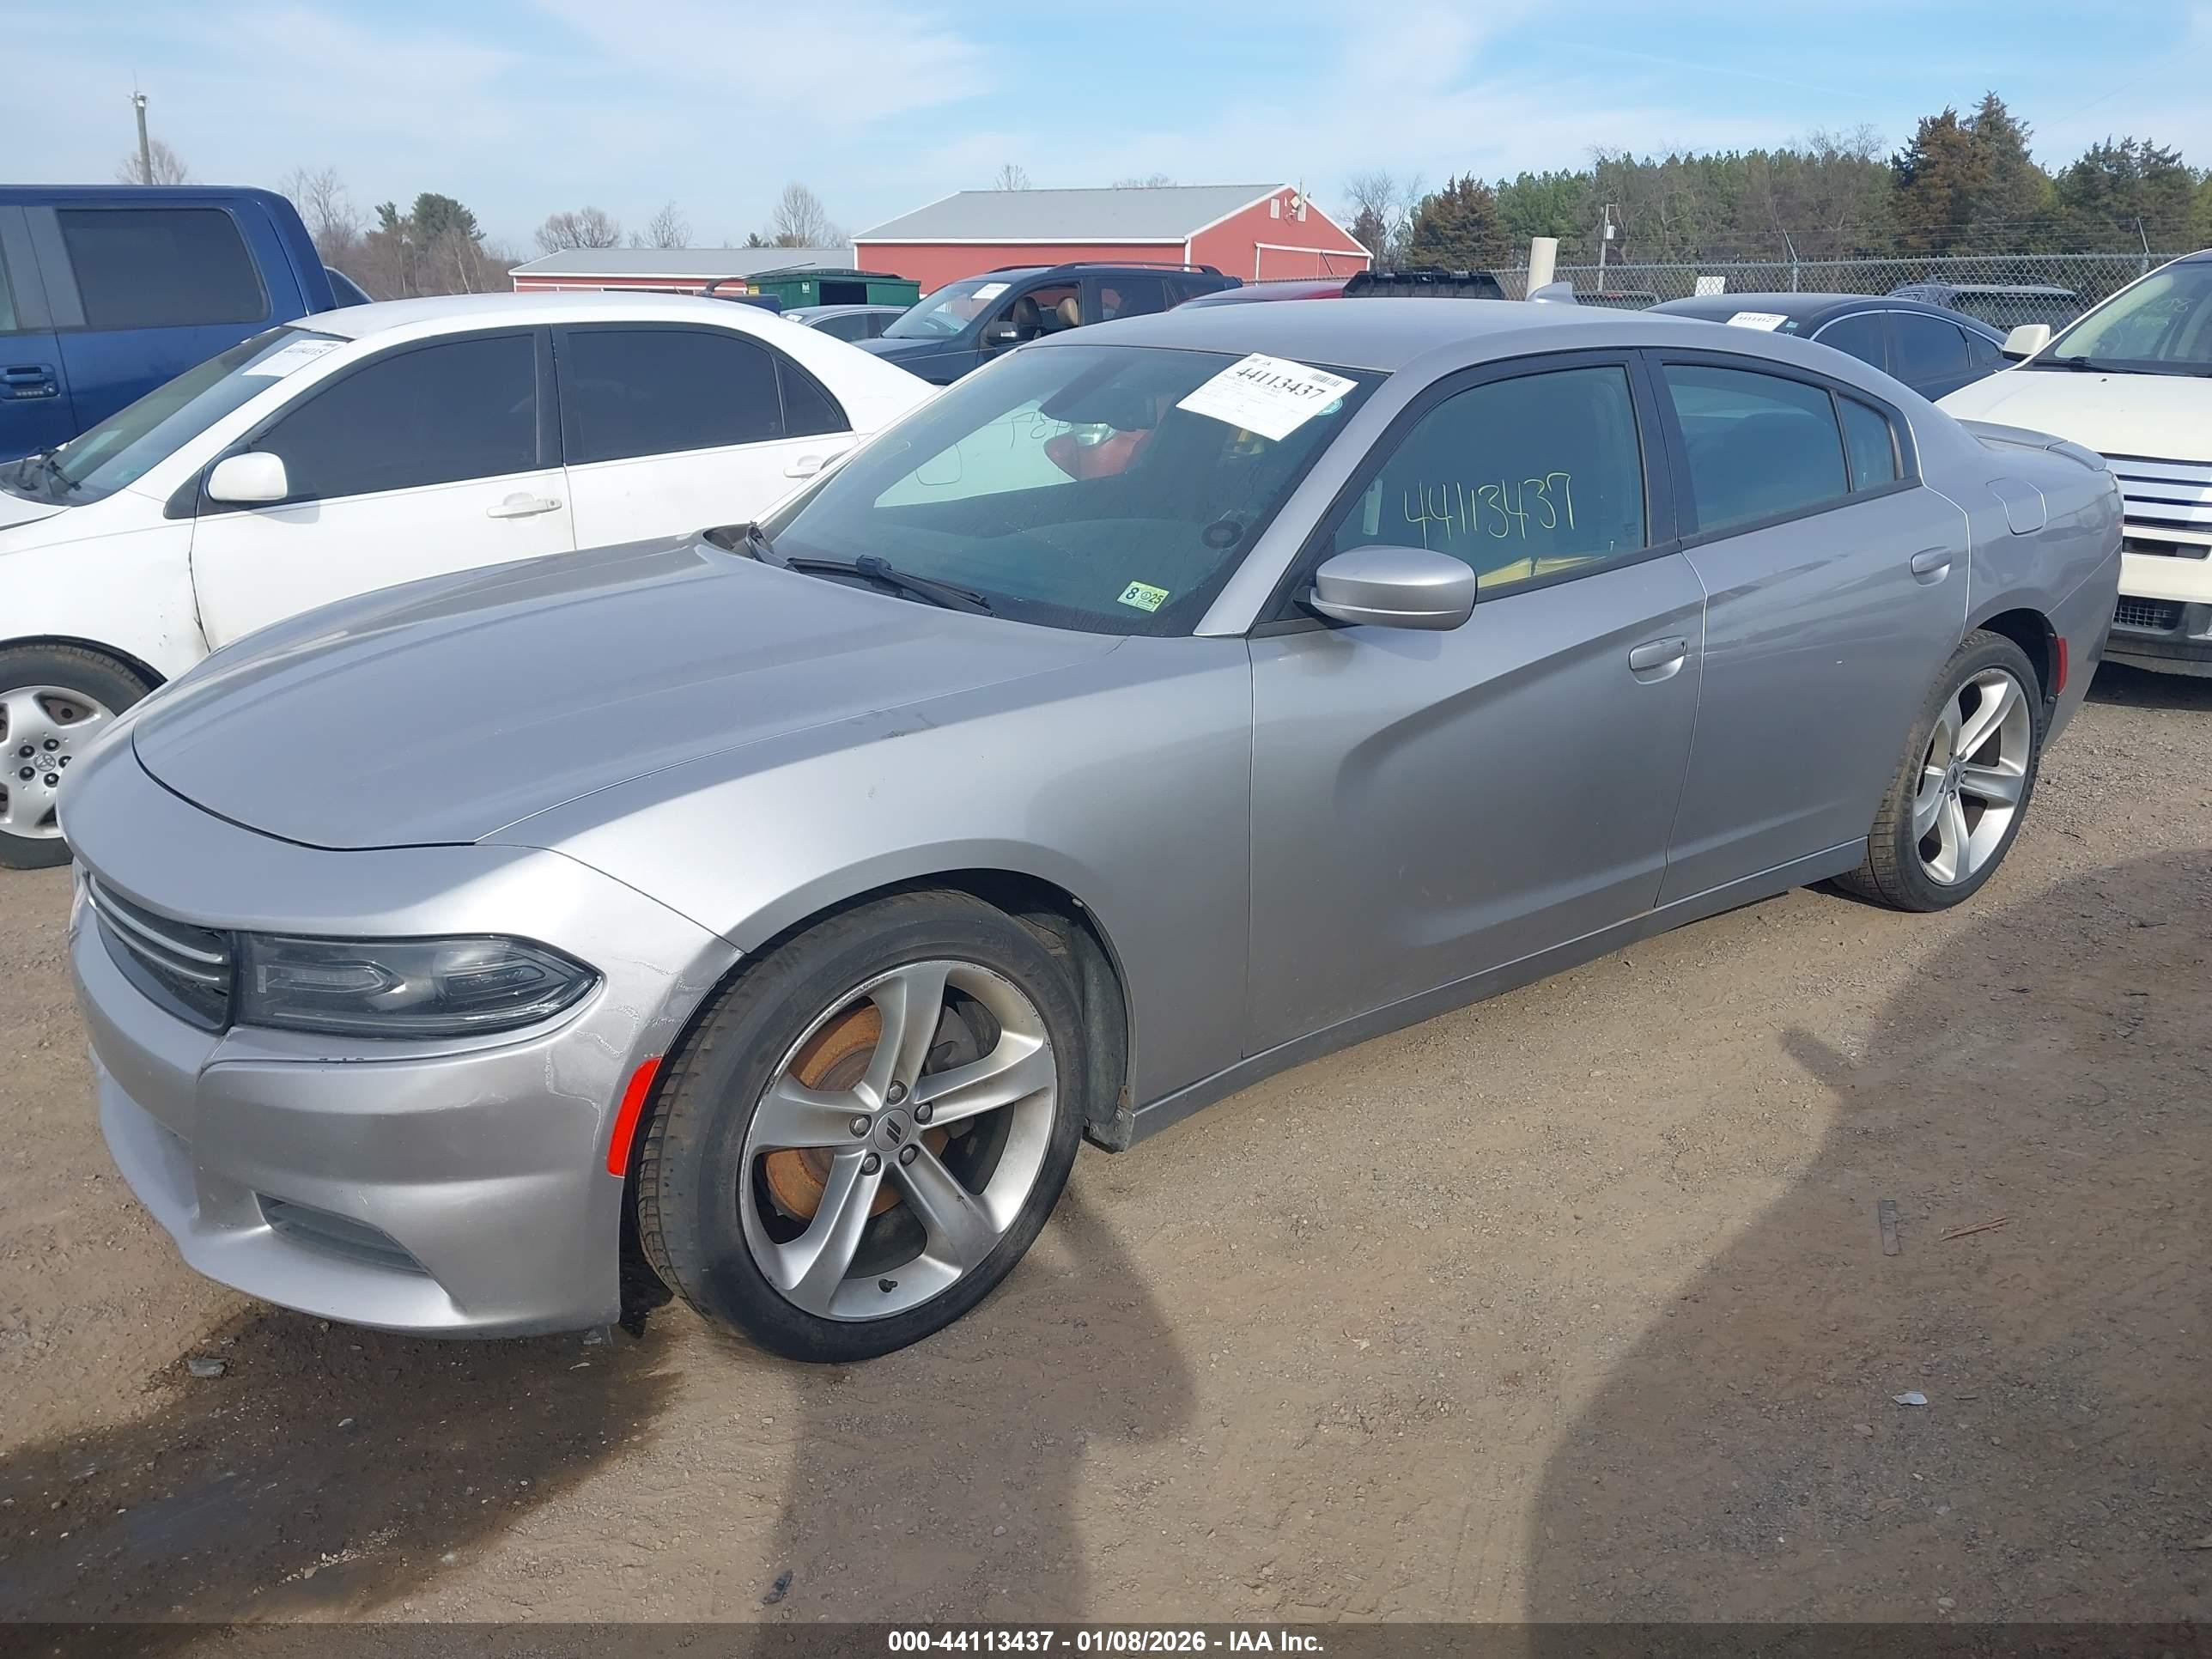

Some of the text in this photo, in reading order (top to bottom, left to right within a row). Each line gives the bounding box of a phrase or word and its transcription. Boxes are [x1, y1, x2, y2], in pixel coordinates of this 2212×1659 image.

[1237, 367, 1326, 400] 44113437
[1402, 472, 1575, 550] 44113437
[1126, 587, 1164, 605] 8 25
